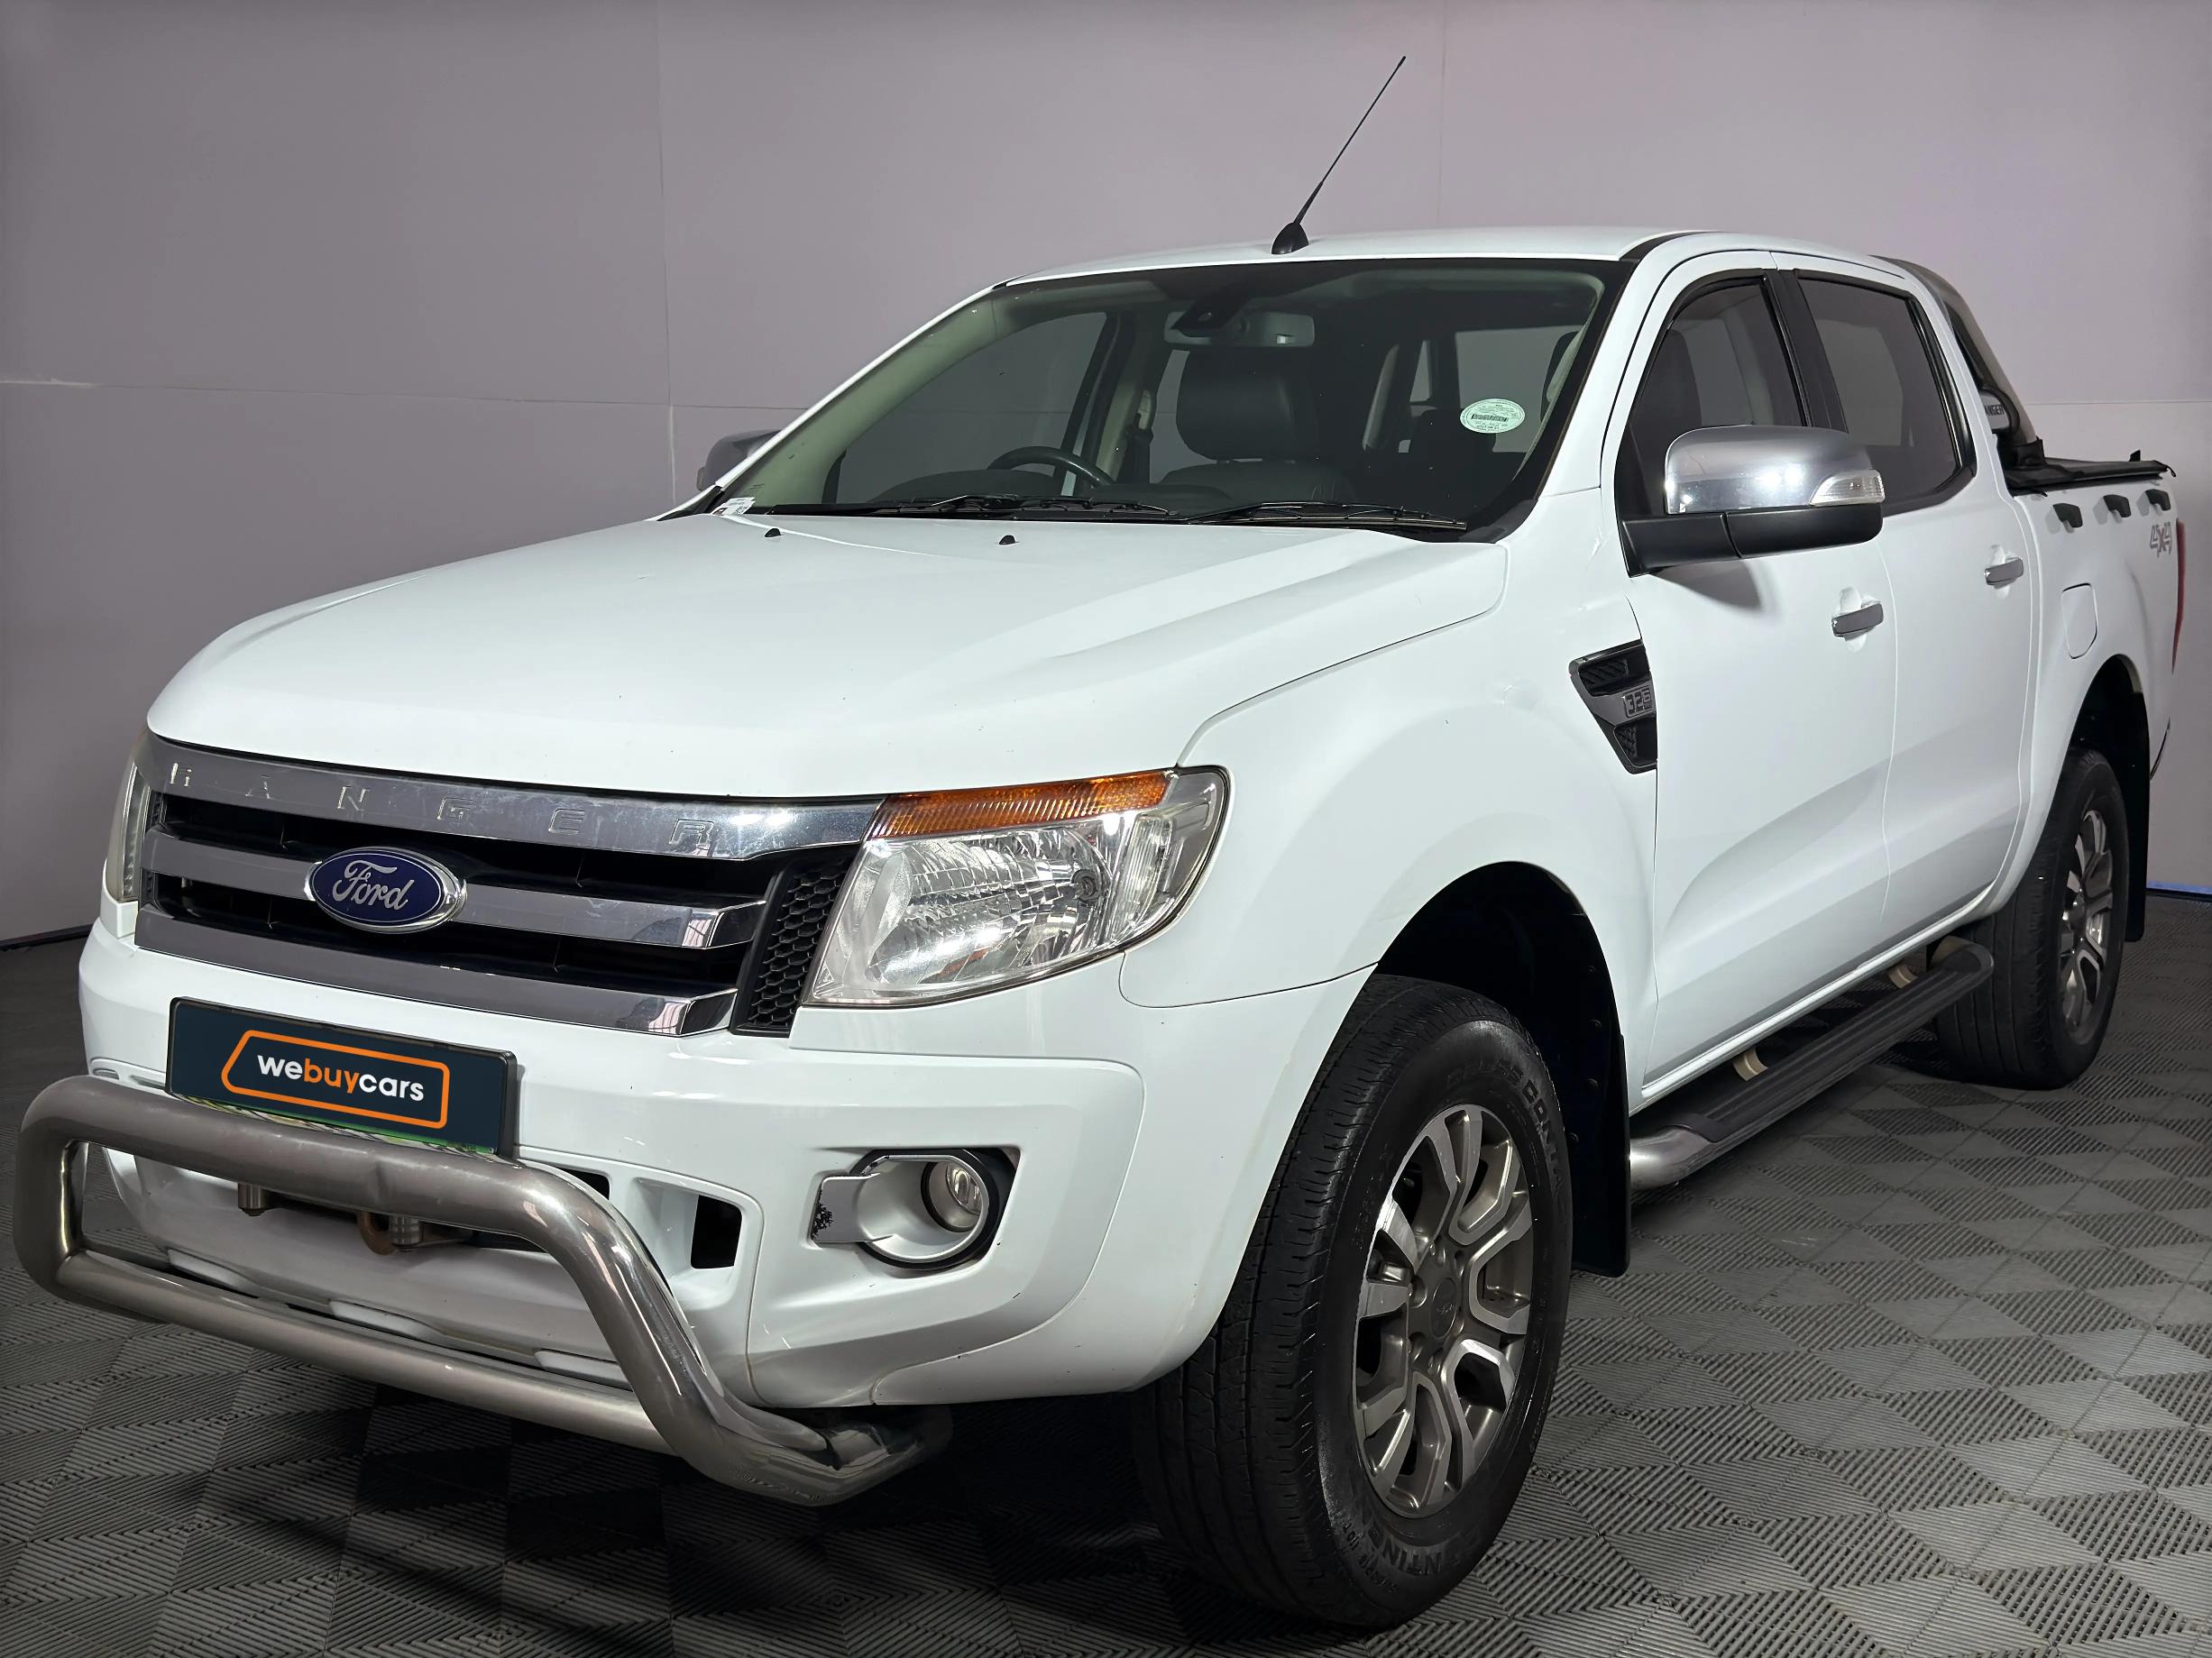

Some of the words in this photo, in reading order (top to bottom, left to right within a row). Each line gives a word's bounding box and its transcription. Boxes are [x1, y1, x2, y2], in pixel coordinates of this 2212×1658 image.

[169, 761, 714, 847] RANGER
[332, 859, 415, 911] Ford
[257, 1054, 425, 1103] webuycars
